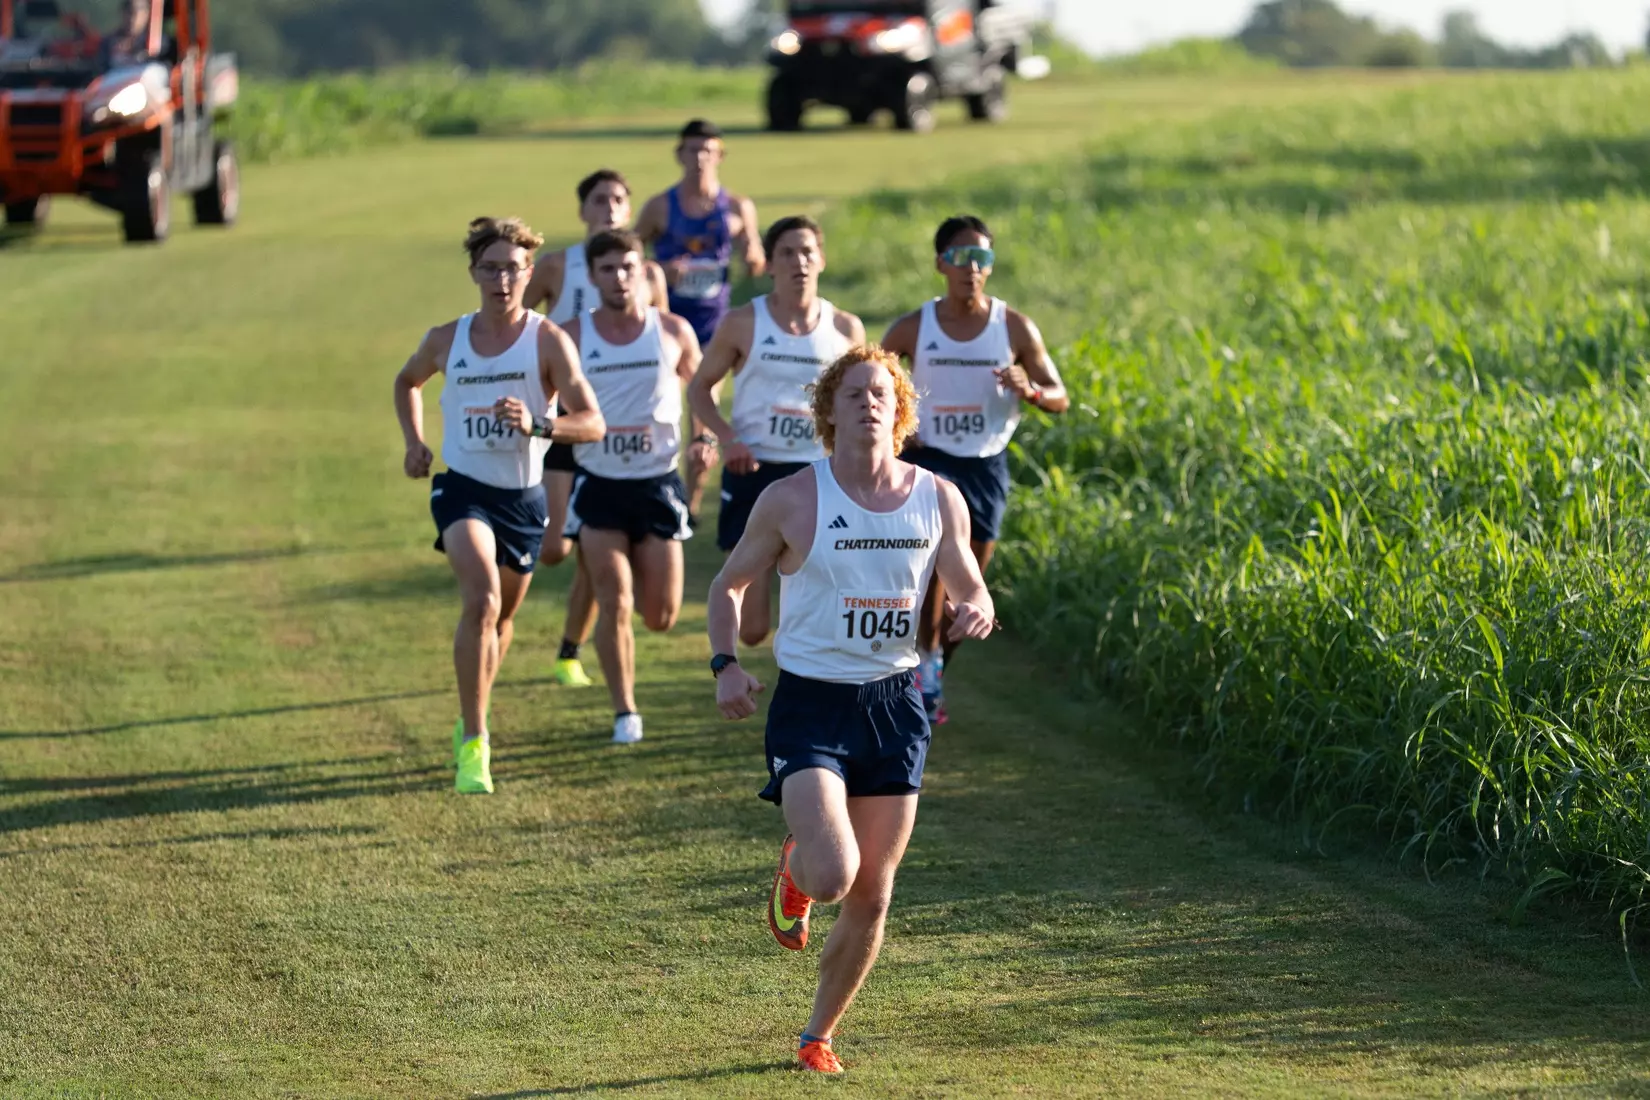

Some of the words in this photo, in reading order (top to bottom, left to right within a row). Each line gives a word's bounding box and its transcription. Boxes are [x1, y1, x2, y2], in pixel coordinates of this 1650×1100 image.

[769, 415, 815, 440] 1050
[933, 414, 985, 435] 1049
[603, 434, 652, 456] 1046
[834, 538, 930, 551] CHATTANOOGA
[843, 597, 912, 609] TENNESSEE
[842, 610, 911, 640] 1045
